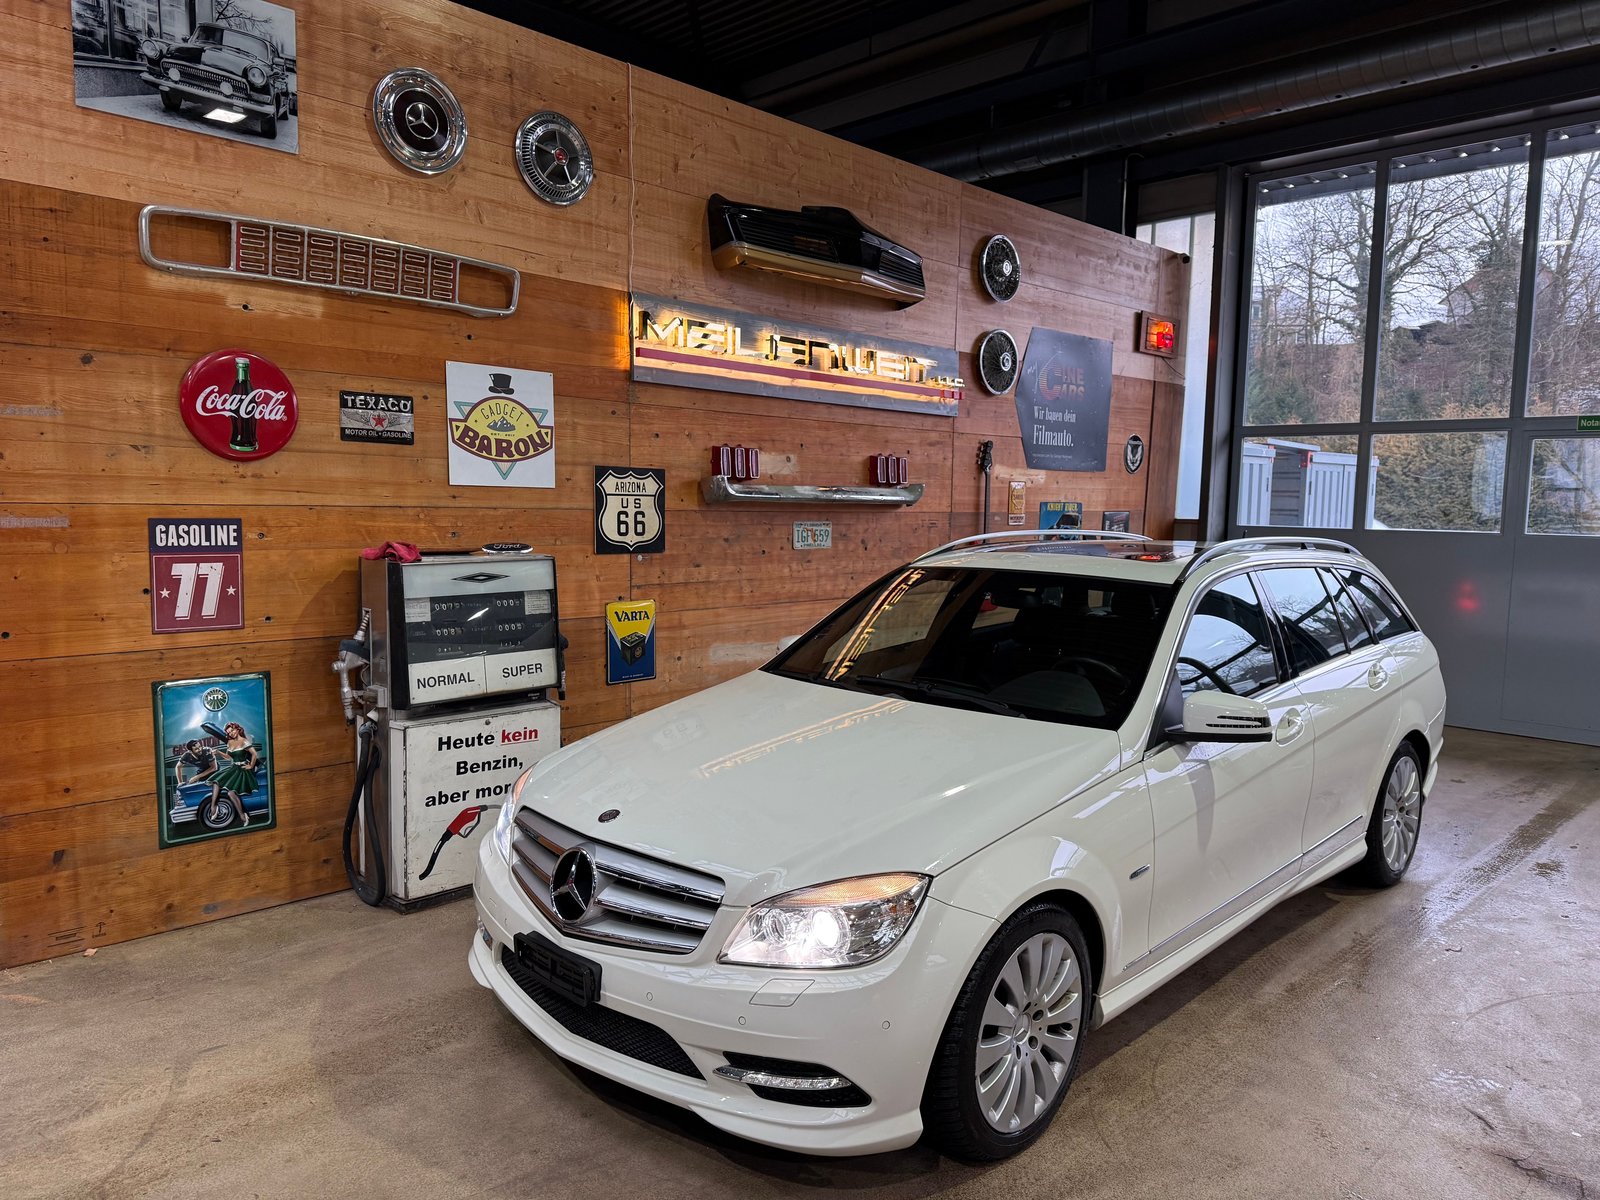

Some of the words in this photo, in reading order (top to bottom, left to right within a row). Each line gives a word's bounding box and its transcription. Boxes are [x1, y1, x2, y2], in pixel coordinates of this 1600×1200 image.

[195, 385, 288, 420] Coca-Cola
[343, 395, 412, 412] TEXACO
[480, 402, 524, 422] GADGET
[1033, 405, 1045, 420] Wir
[1045, 406, 1063, 422] bauen
[1063, 409, 1076, 423] dein
[345, 428, 367, 436] MOTOR
[382, 431, 412, 439] GASOLINE
[456, 424, 550, 458] BARON
[1033, 424, 1074, 447] Filmauto.
[614, 481, 647, 493] ARIZONA
[616, 510, 646, 537] 66
[155, 524, 238, 547] GASOLINE
[171, 562, 225, 620] 77
[614, 610, 650, 622] VARTA
[416, 671, 475, 690] NORMAL
[502, 662, 543, 679] SUPER
[437, 732, 495, 752] Heute
[501, 727, 539, 745] kein
[456, 755, 523, 776] Benzin,
[424, 790, 470, 808] aber
